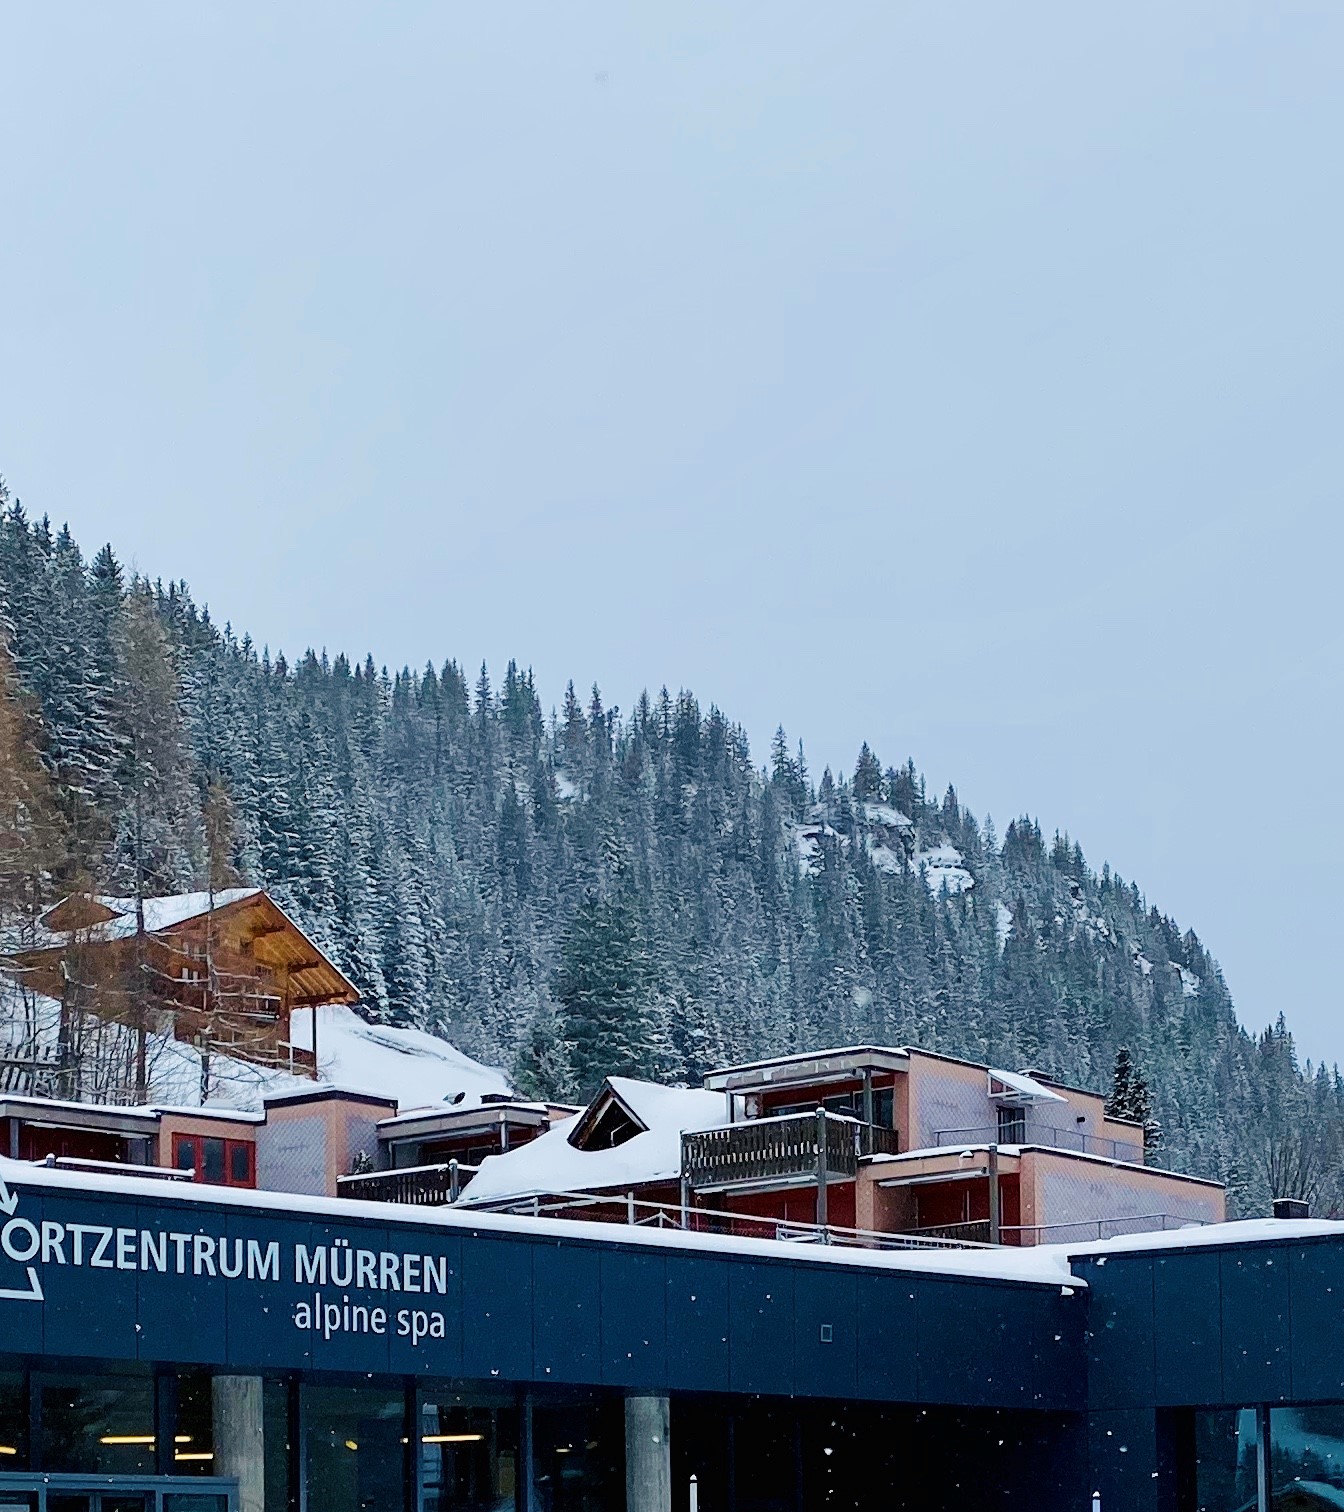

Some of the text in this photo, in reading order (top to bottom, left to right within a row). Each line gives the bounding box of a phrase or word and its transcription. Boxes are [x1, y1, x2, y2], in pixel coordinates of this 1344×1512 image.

[295, 1238, 447, 1294] MÜRREN
[294, 1291, 446, 1346] alpine spa
